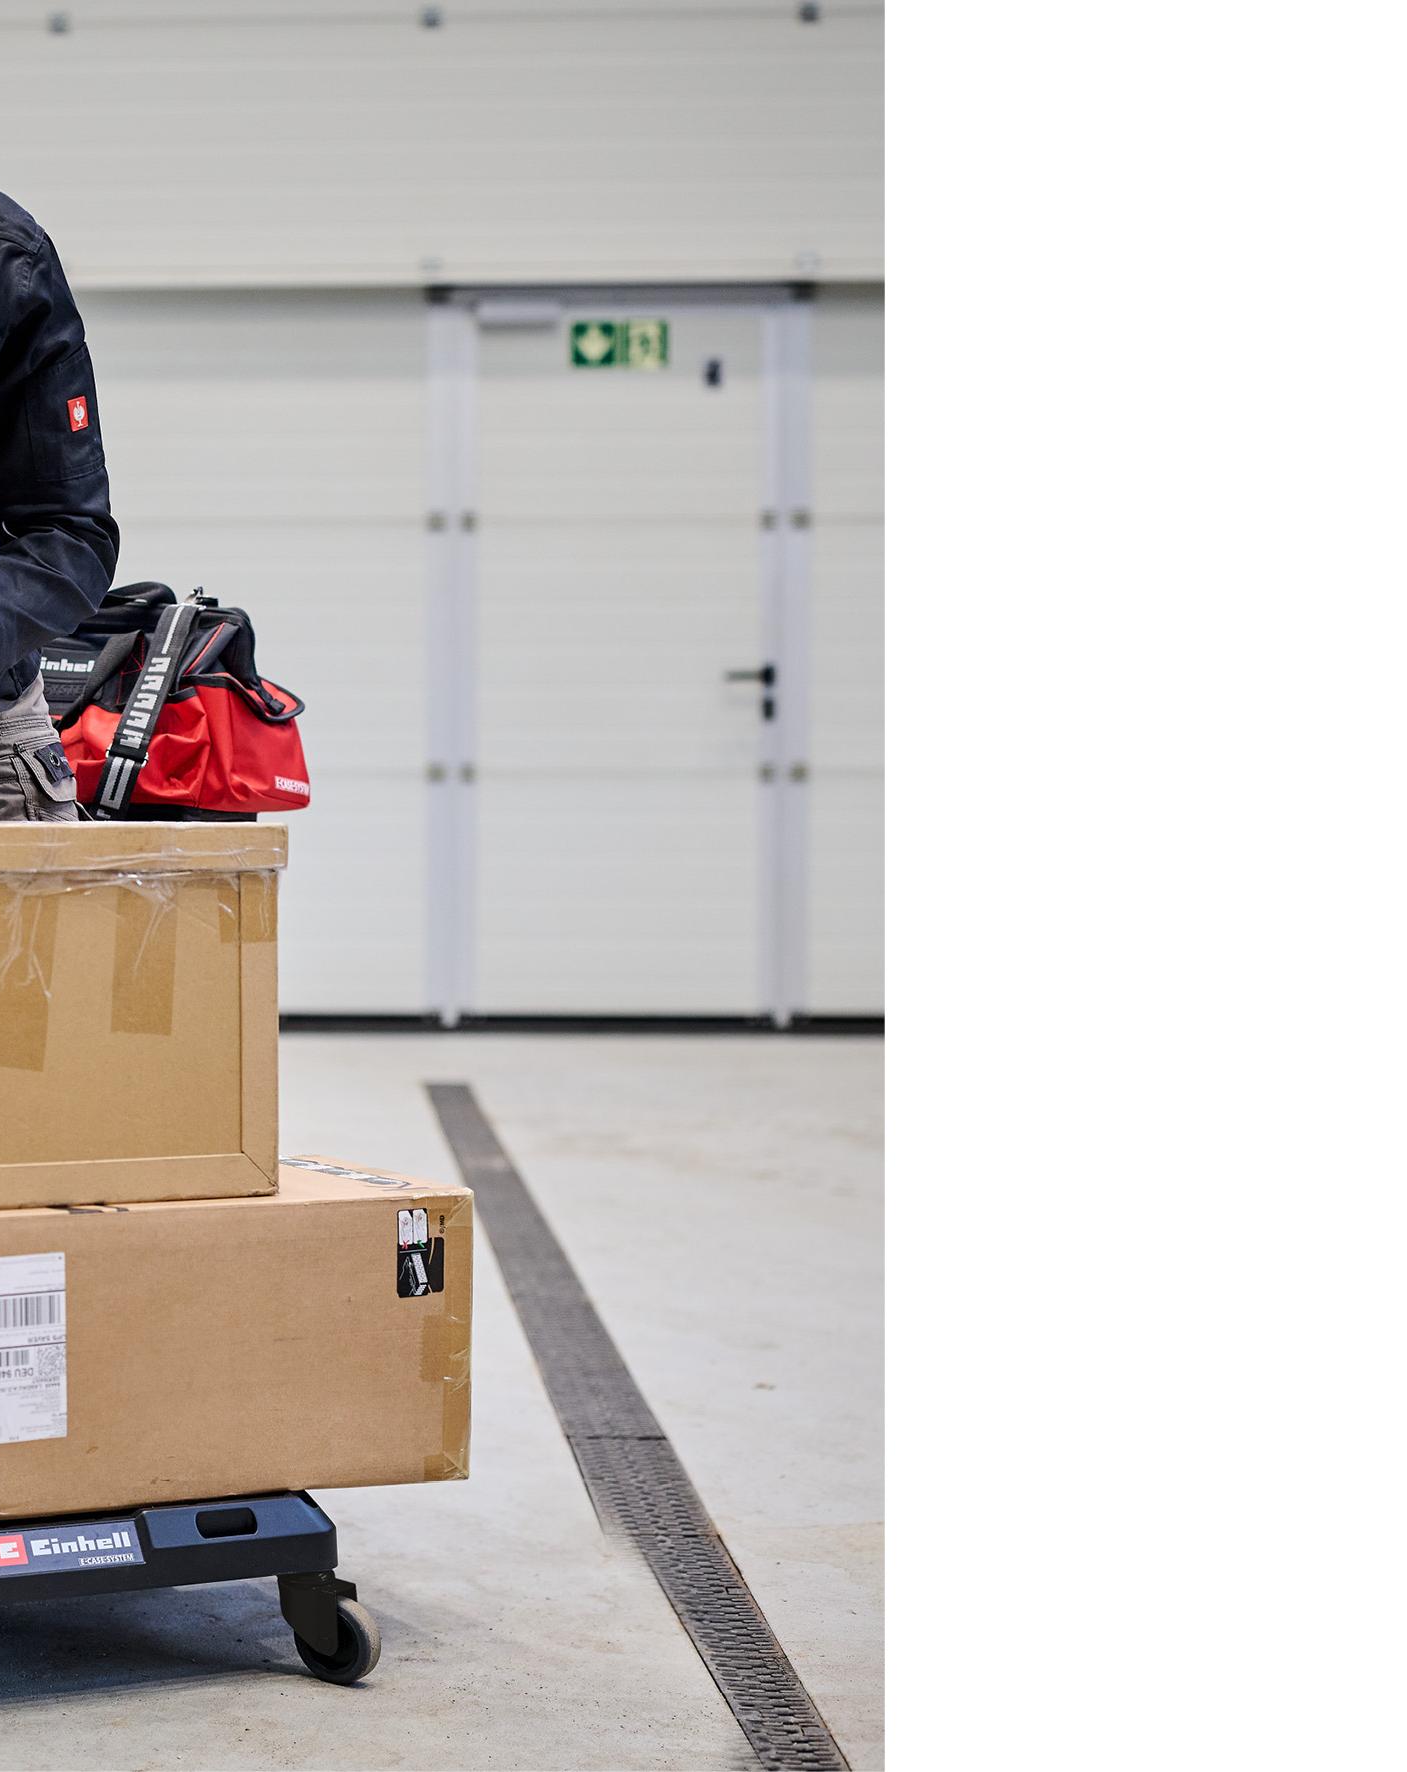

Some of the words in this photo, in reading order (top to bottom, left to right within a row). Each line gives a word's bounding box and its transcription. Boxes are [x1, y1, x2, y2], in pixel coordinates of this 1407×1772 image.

[40, 656, 96, 673] inhel
[14, 1367, 34, 1378] DEU
[30, 1531, 132, 1556] Einhell
